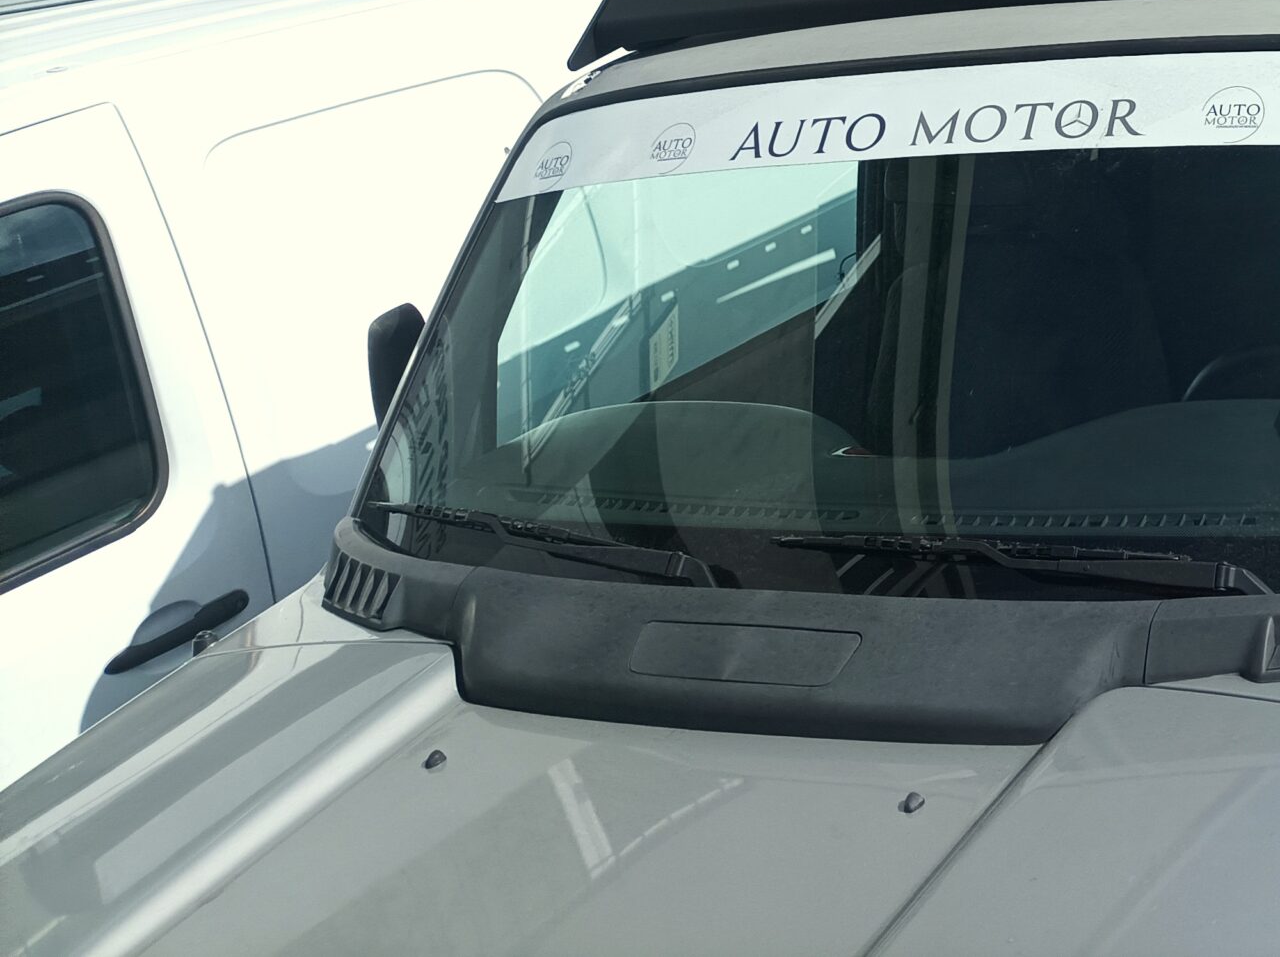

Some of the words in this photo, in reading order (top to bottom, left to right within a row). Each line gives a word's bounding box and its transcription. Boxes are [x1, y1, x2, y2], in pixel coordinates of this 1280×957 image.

[1205, 103, 1261, 117] AUTO
[1203, 115, 1257, 126] MOTOR
[728, 113, 886, 160] AUTO
[909, 99, 1146, 146] MOTOR
[652, 137, 693, 152] AUTO
[649, 148, 688, 160] MOTOR
[537, 154, 570, 171] AUTO
